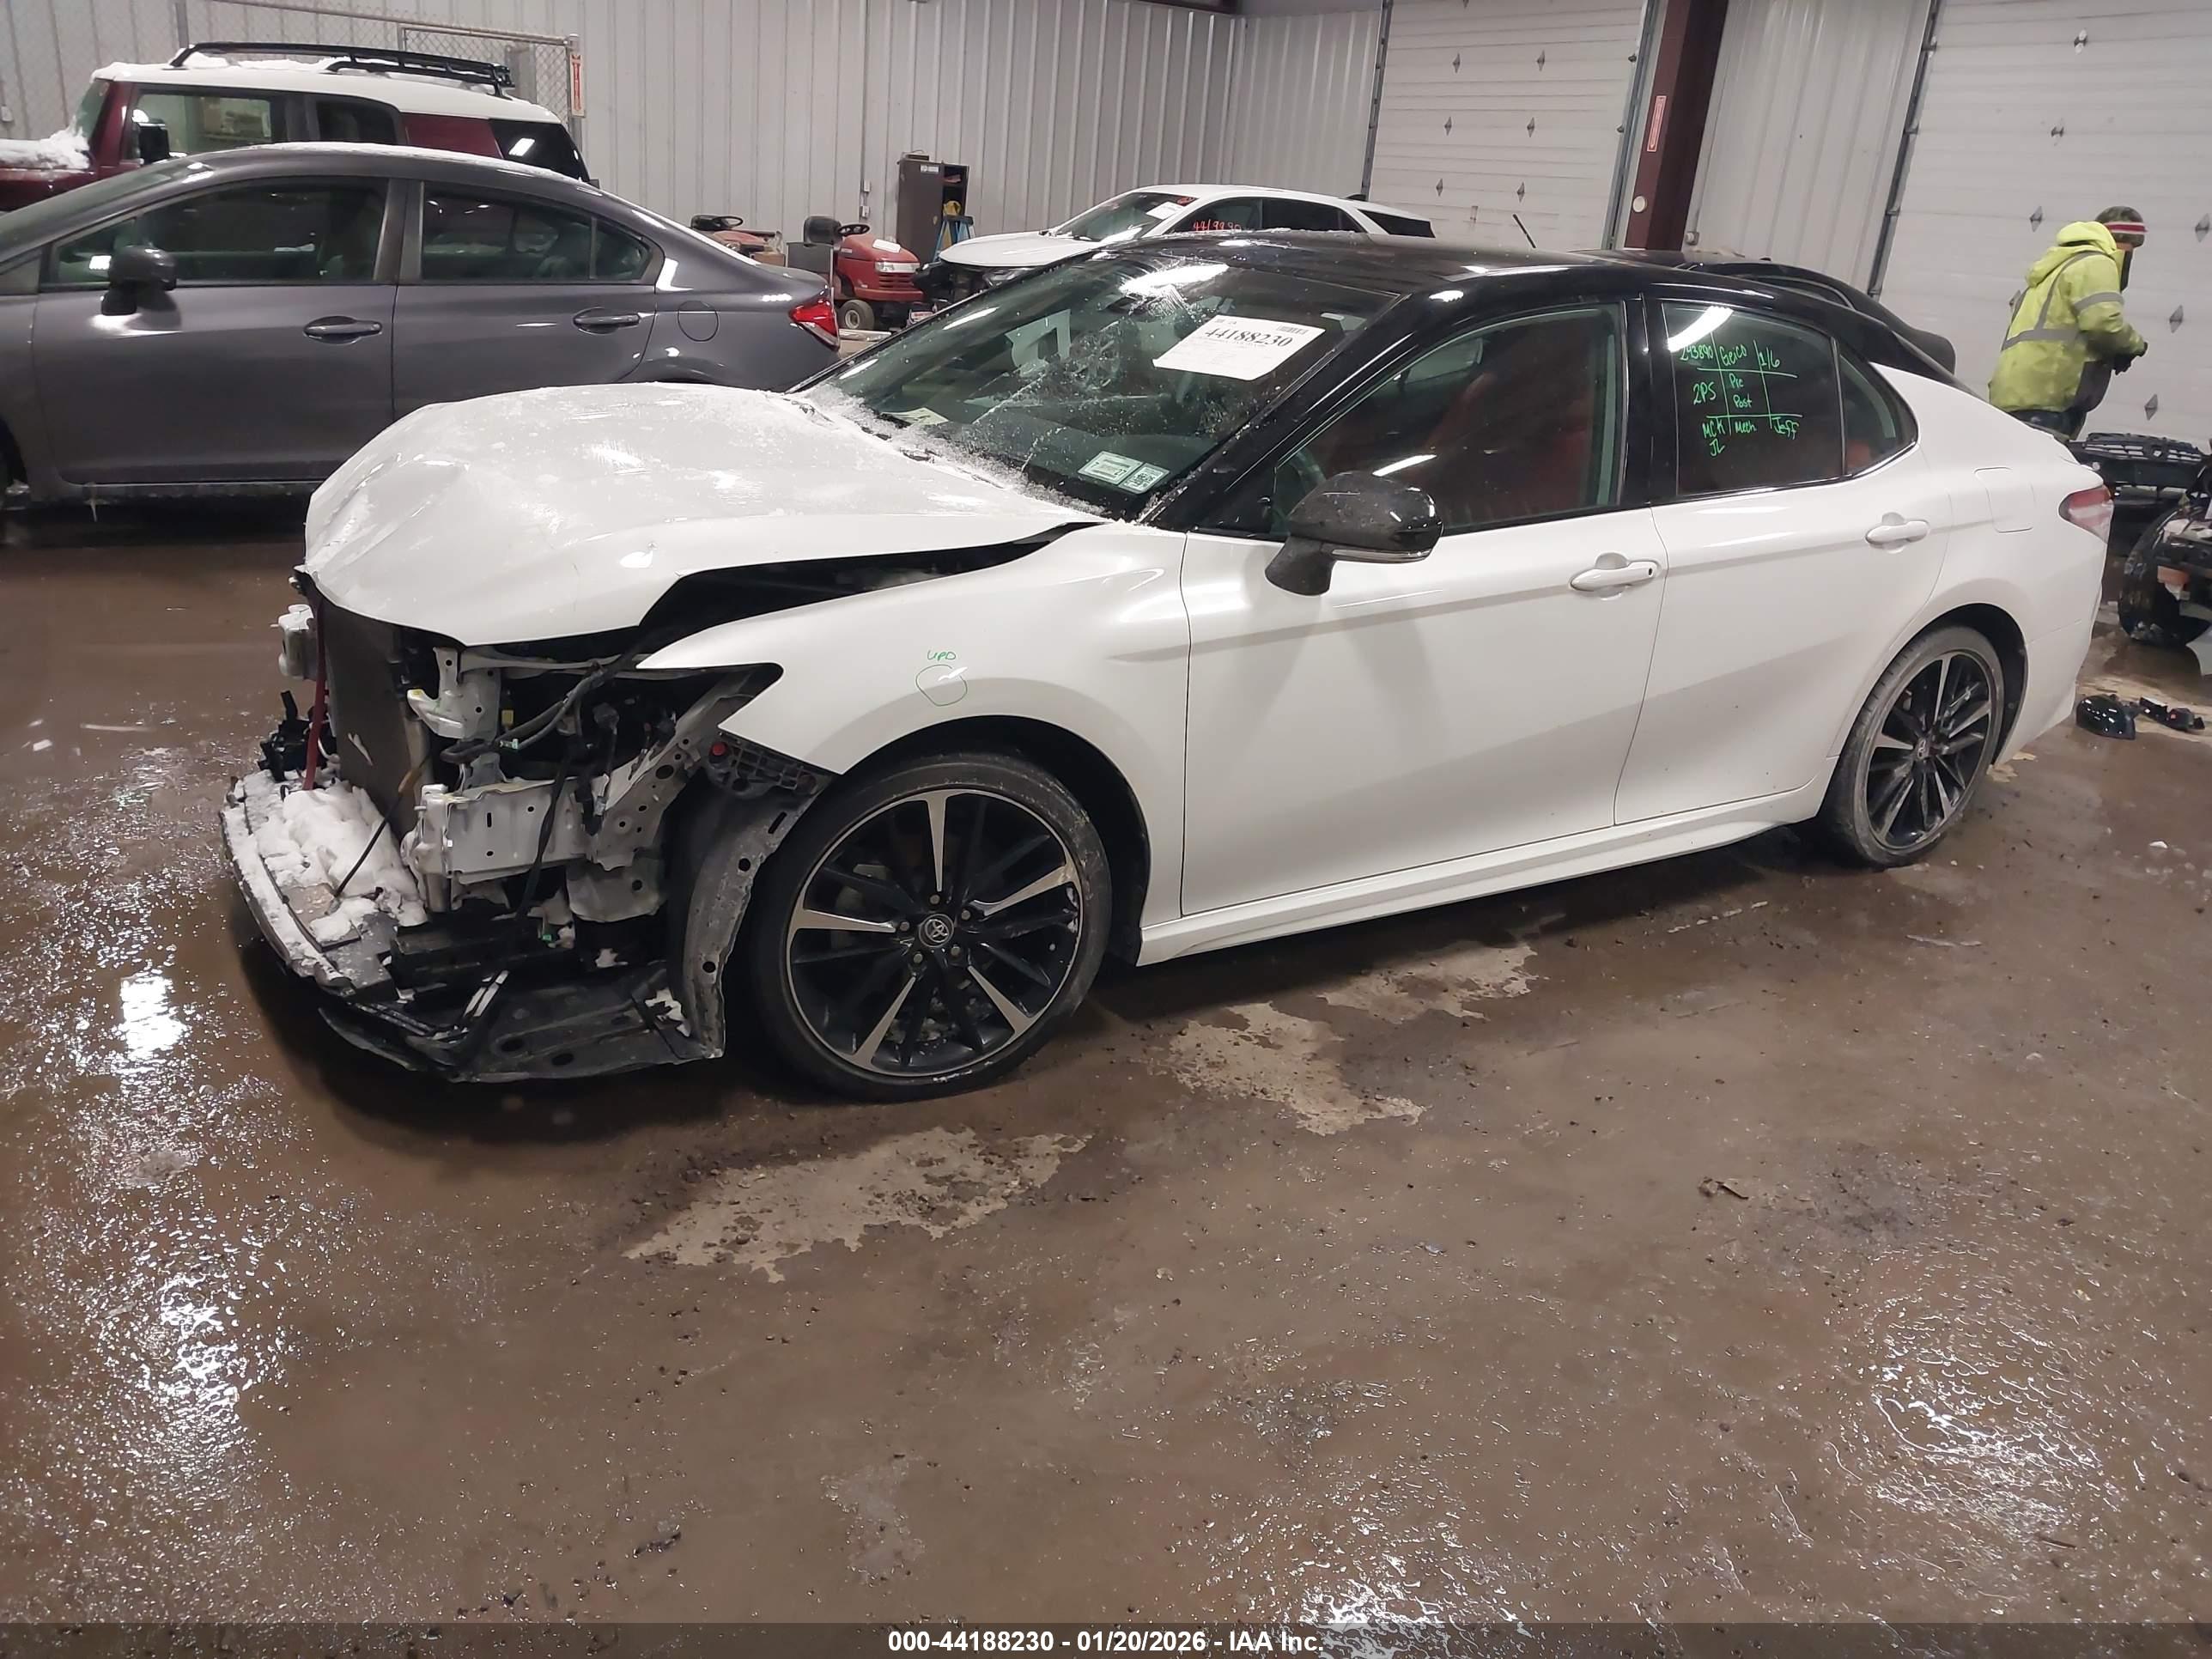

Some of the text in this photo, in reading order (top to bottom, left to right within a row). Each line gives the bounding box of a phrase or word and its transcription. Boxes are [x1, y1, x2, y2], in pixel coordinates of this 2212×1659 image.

[1204, 327, 1293, 347] 44188230
[1719, 343, 1747, 367] Geico
[1692, 381, 1717, 404] 2PS
[1732, 393, 1753, 409] Post
[1771, 416, 1800, 440] Jeff
